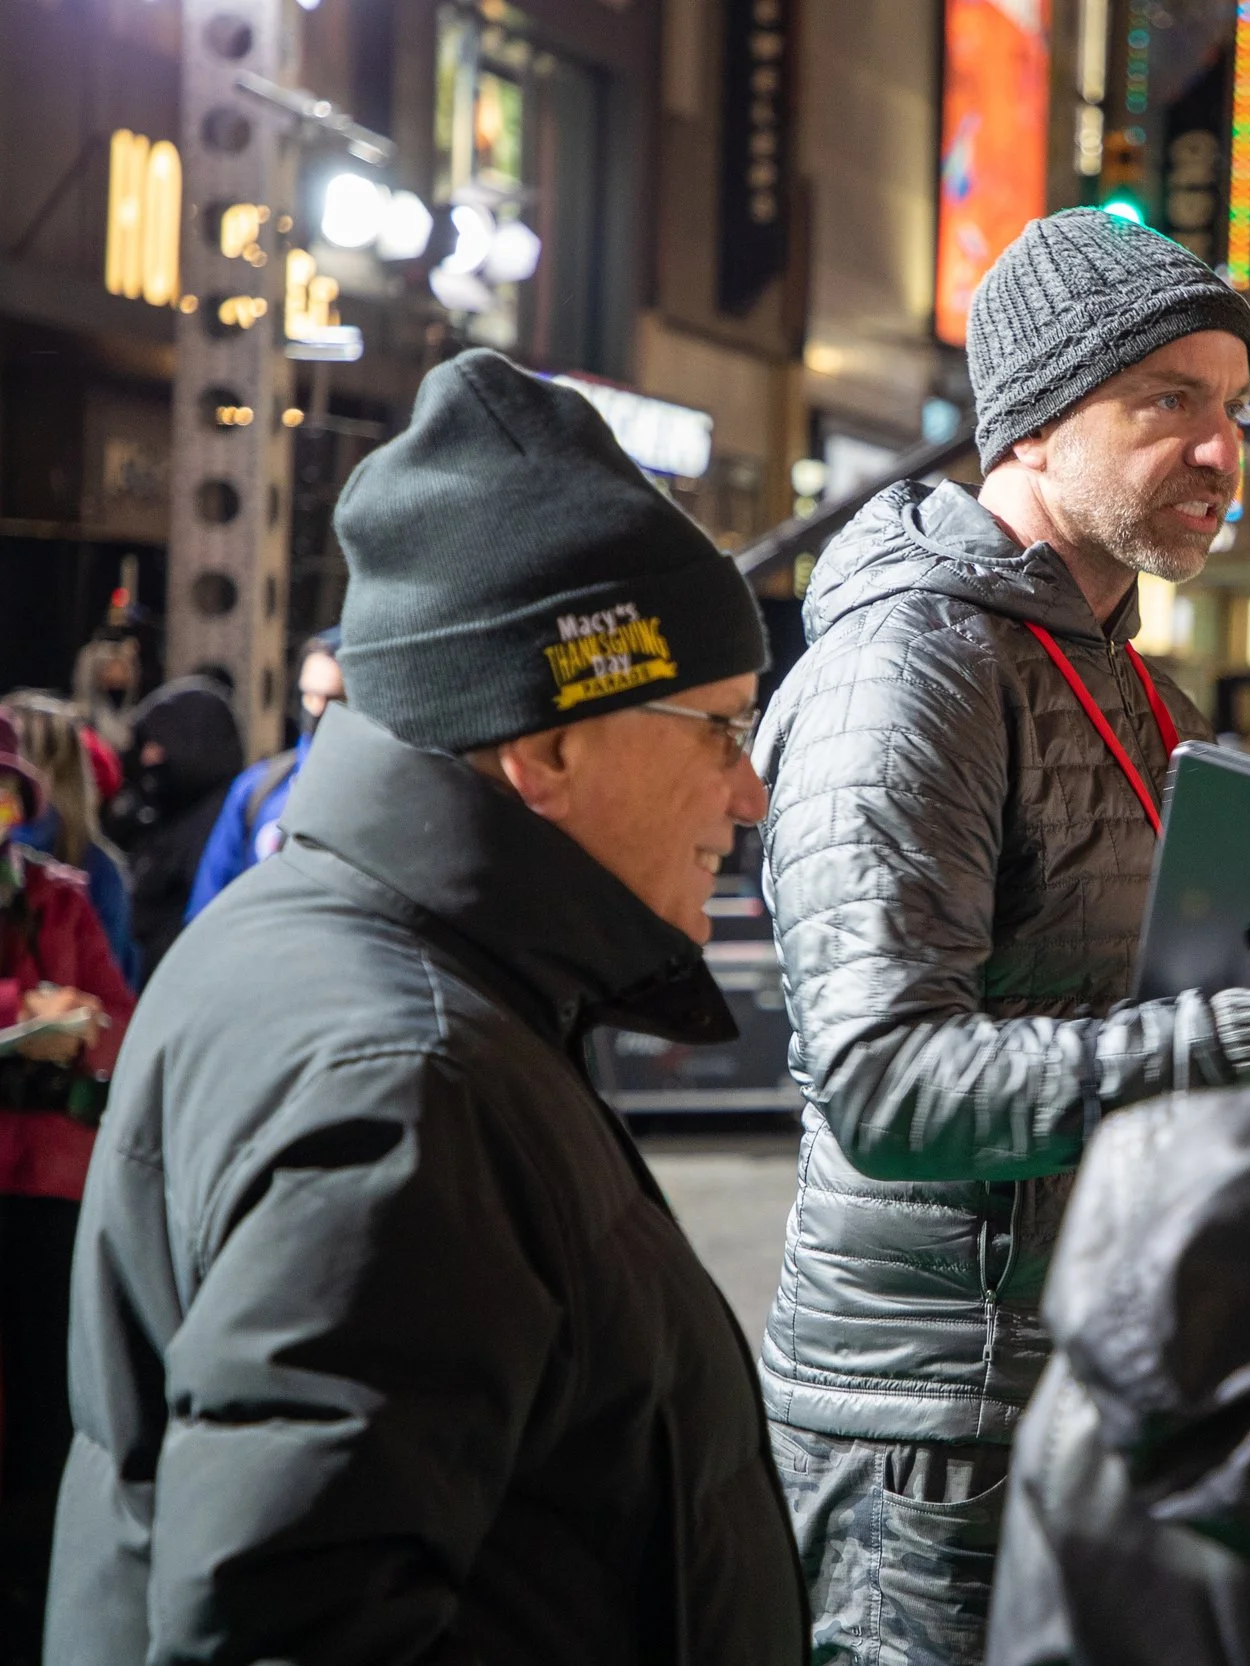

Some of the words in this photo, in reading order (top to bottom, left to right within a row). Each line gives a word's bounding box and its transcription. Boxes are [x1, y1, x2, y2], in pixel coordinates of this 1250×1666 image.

[544, 616, 670, 690] THANKSGIVING
[592, 654, 632, 678] Day
[582, 667, 650, 694] PARADE
